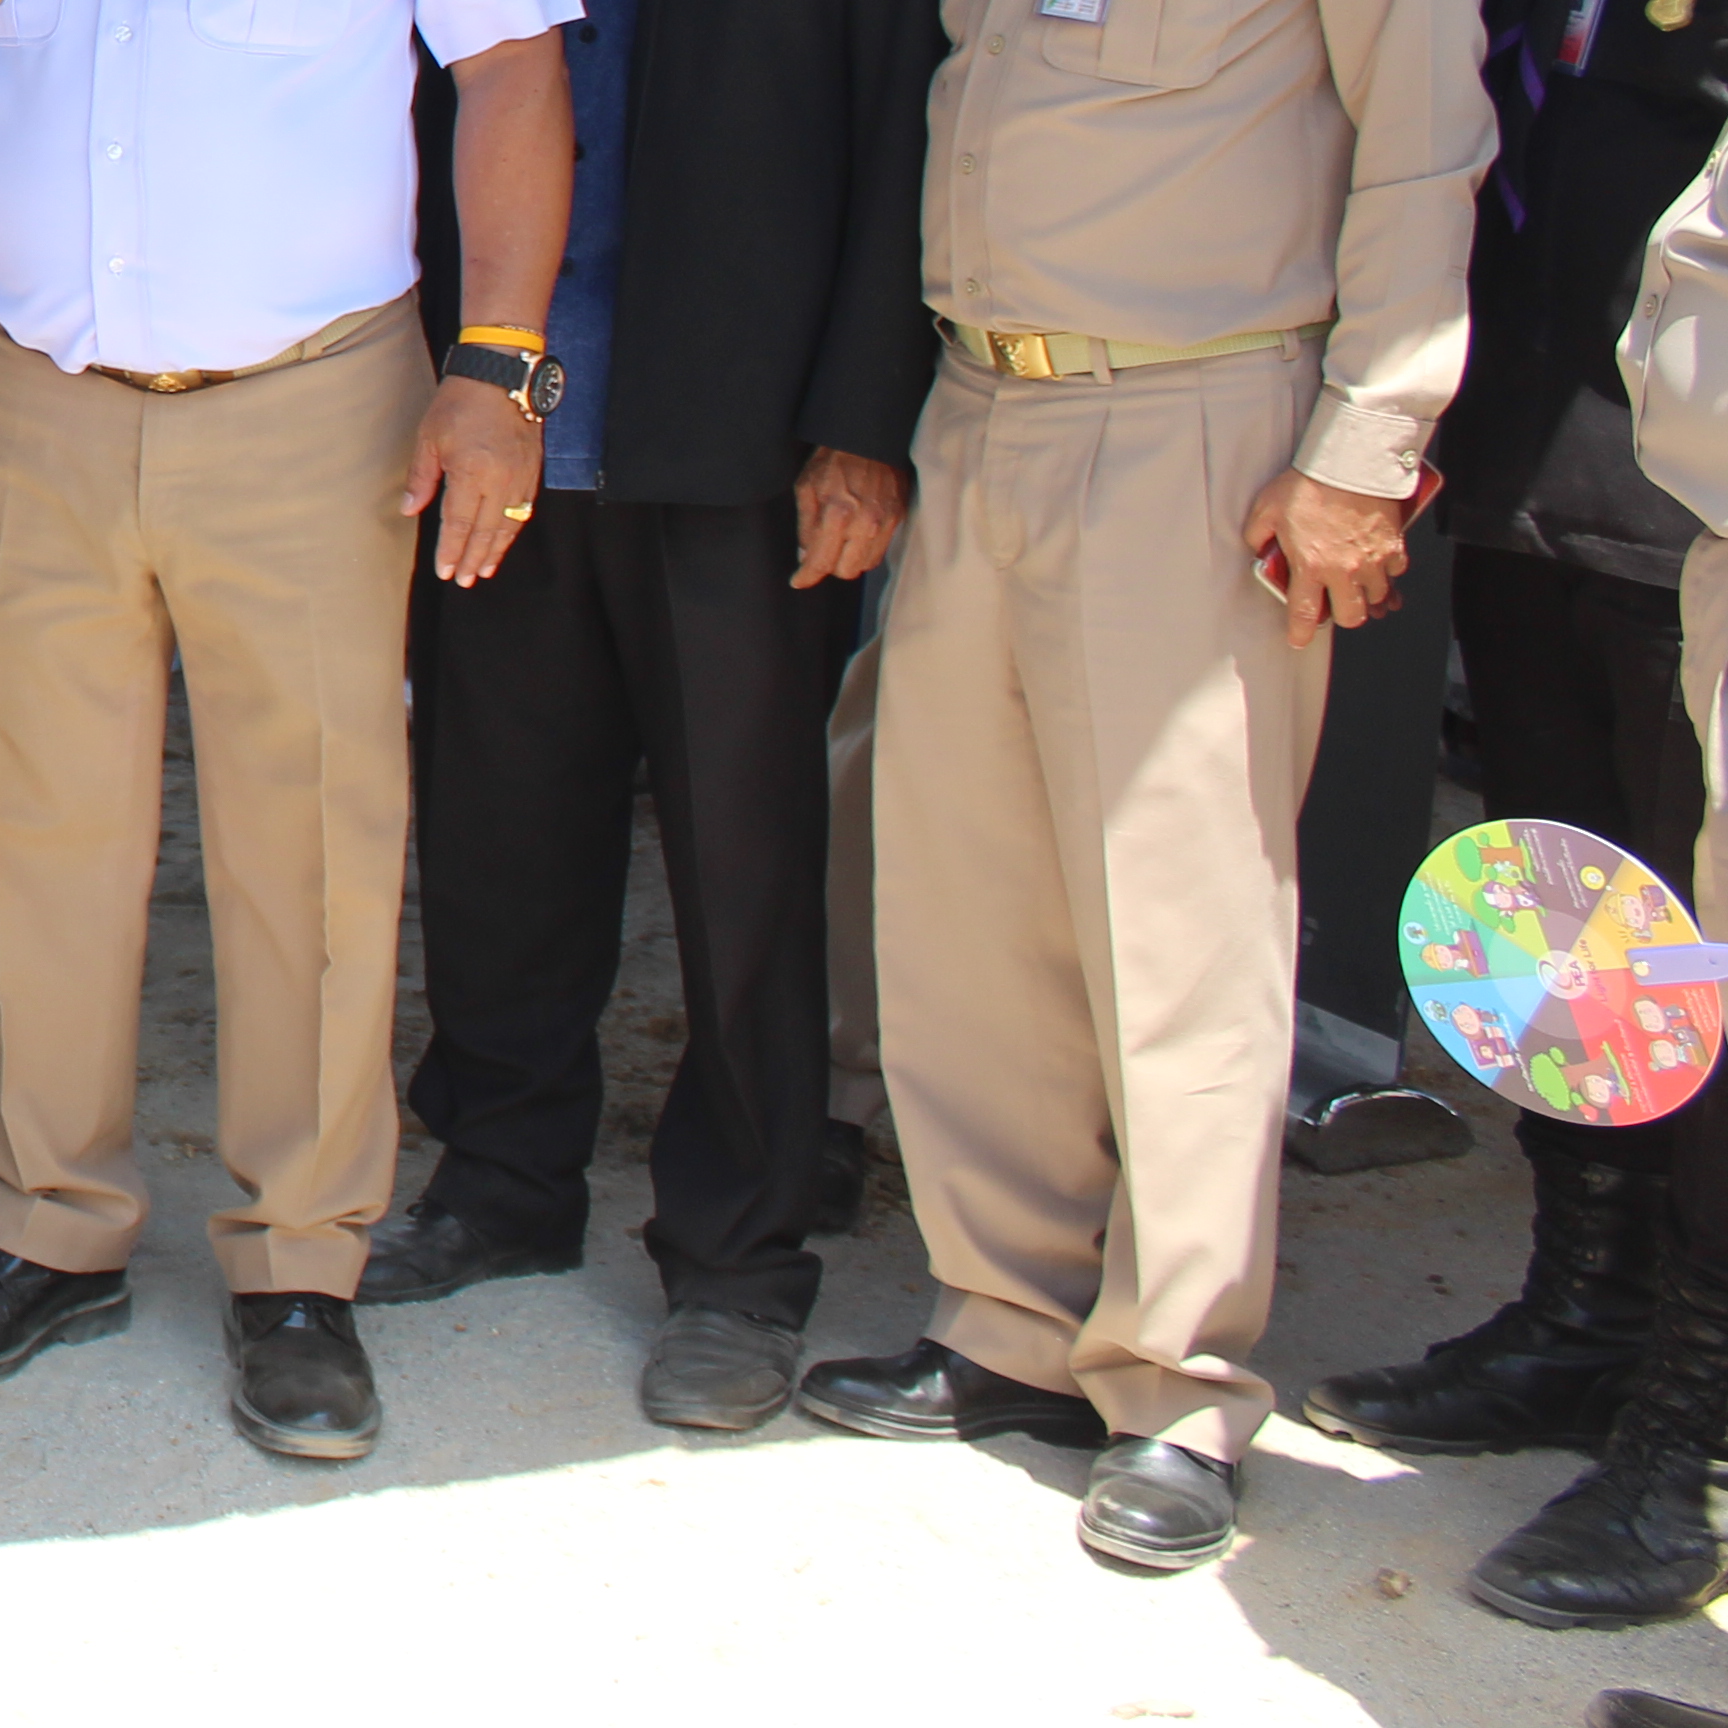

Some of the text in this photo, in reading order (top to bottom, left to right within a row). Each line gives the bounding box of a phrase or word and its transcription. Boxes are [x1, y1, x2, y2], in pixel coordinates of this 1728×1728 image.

[1578, 939, 1592, 958] Life
[1568, 960, 1586, 987] PEA
[1588, 960, 1597, 975] for
